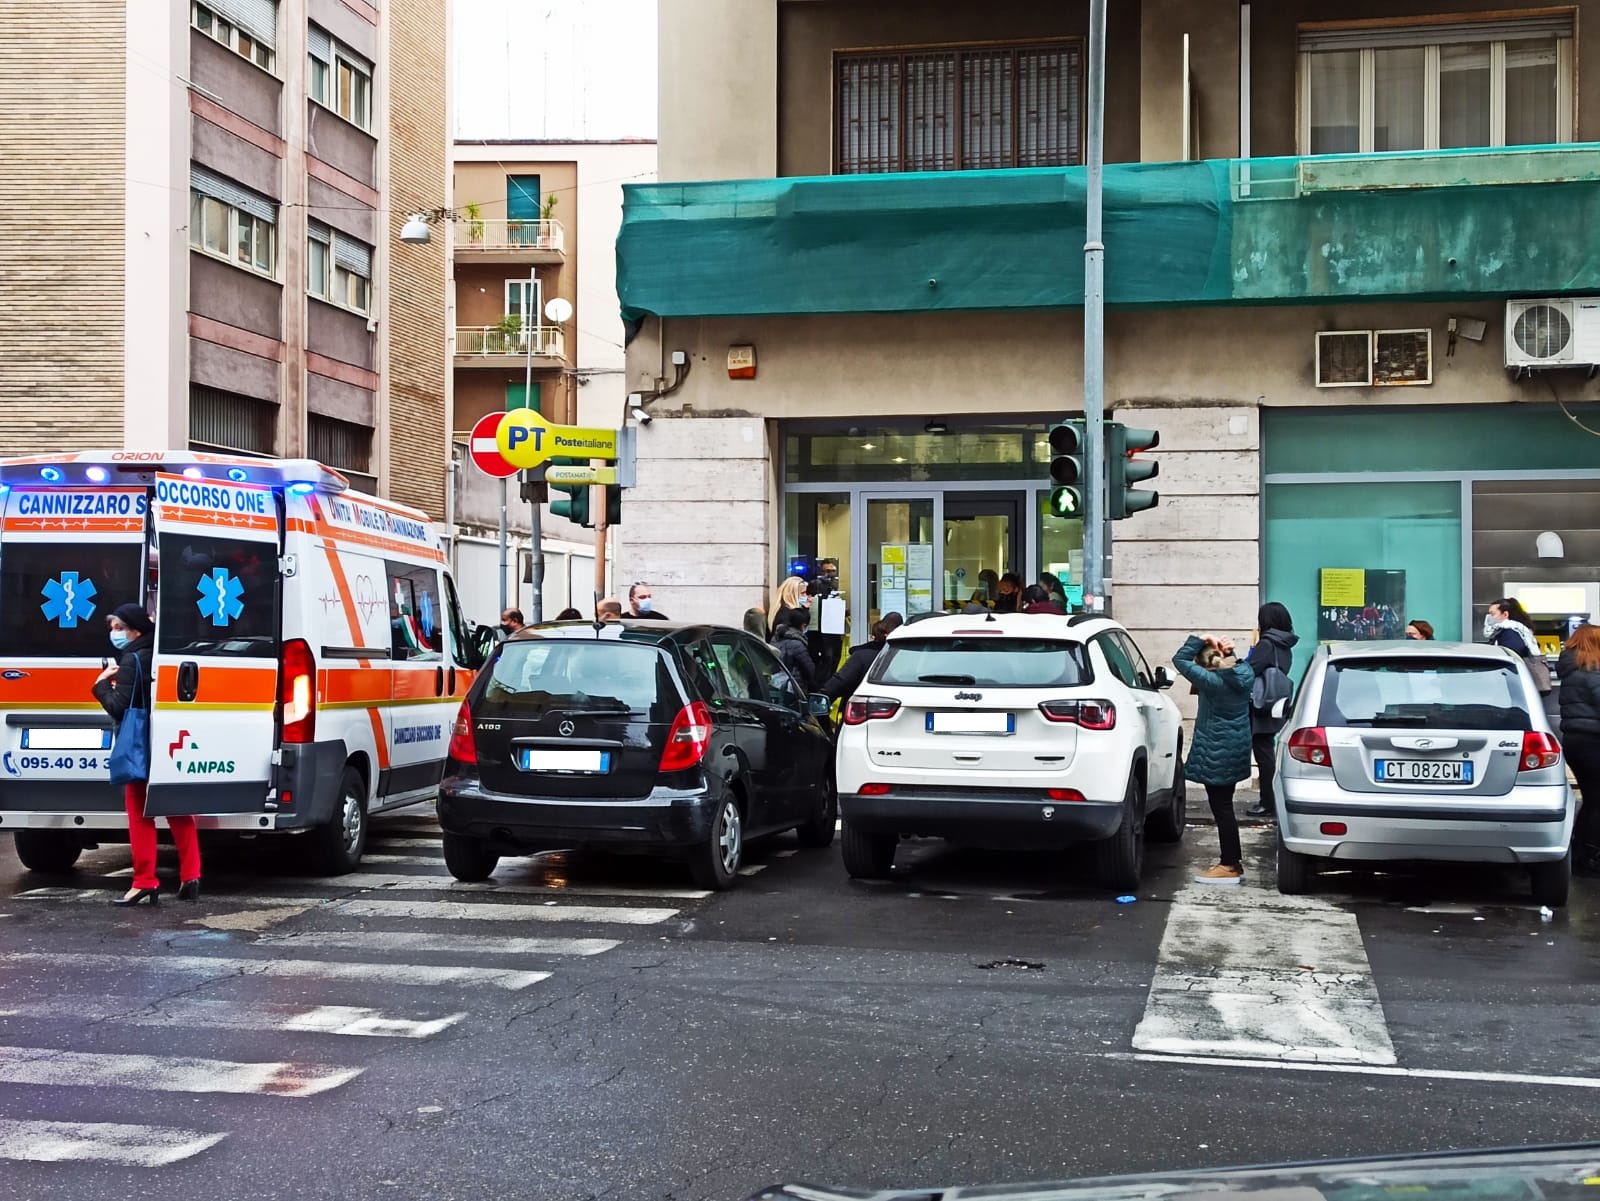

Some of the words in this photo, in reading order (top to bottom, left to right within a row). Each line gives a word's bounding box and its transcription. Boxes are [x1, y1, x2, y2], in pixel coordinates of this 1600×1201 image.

[508, 426, 546, 452] PT
[554, 436, 613, 449] Posteitaliane
[112, 452, 164, 461] ORION
[19, 495, 130, 515] CANNIZZARO
[235, 490, 265, 514] ONE
[954, 691, 983, 702] Jeep
[21, 757, 74, 769] 095.40
[79, 757, 98, 769] 34
[187, 760, 236, 774] ANPAS
[1386, 762, 1405, 778] CT
[1412, 764, 1462, 779] 082GW
